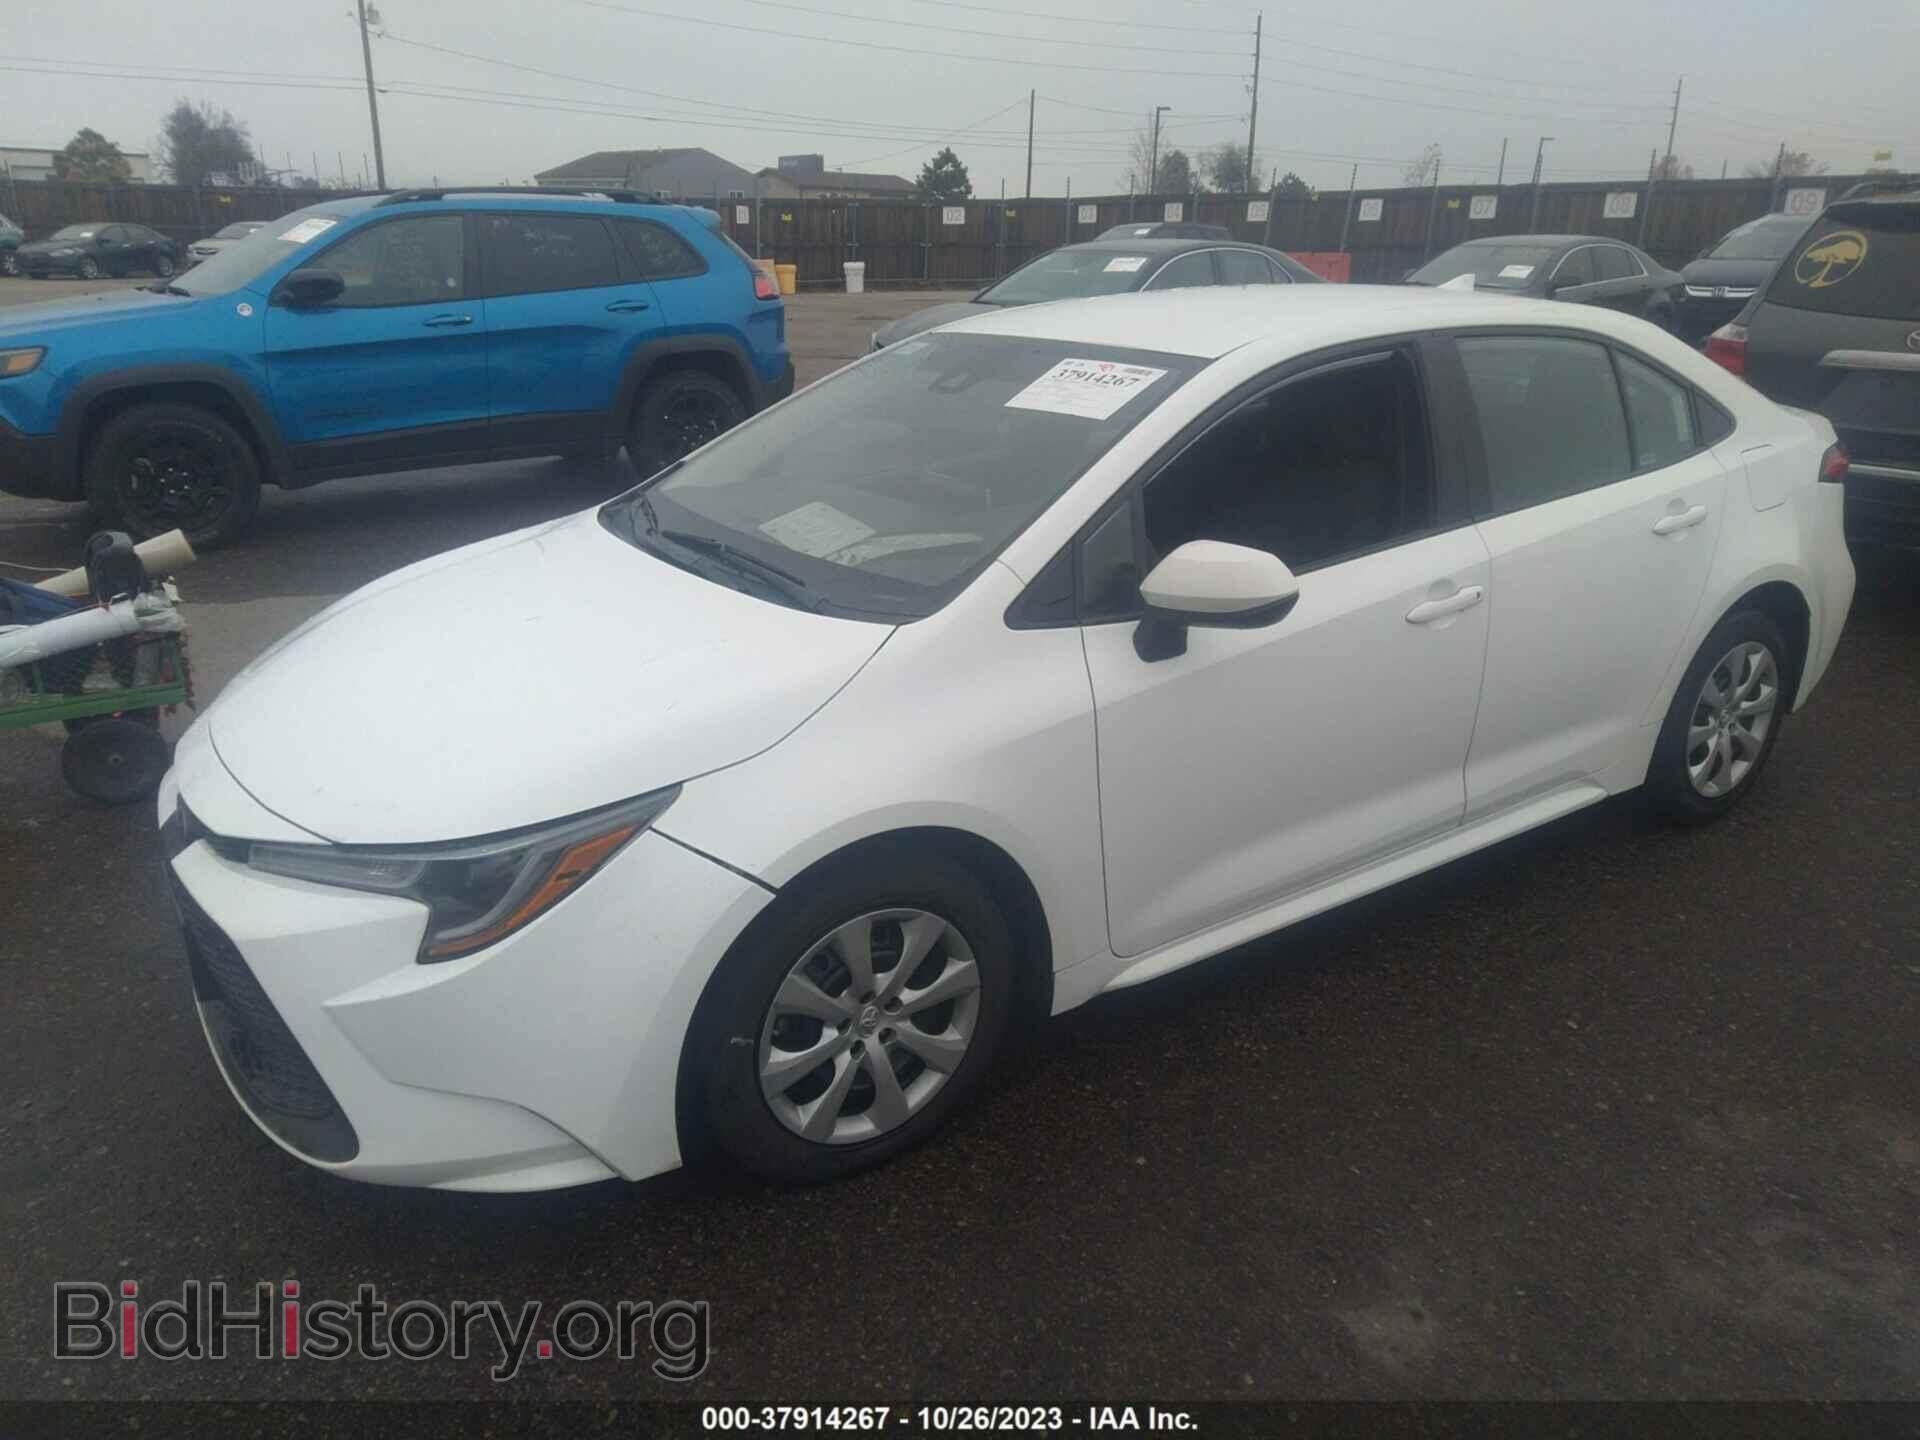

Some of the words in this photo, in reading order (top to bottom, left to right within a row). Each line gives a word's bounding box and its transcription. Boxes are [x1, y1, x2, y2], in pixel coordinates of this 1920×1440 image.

[1473, 198, 1494, 216] 07
[1791, 191, 1818, 212] 09
[1052, 368, 1141, 388] 37914267
